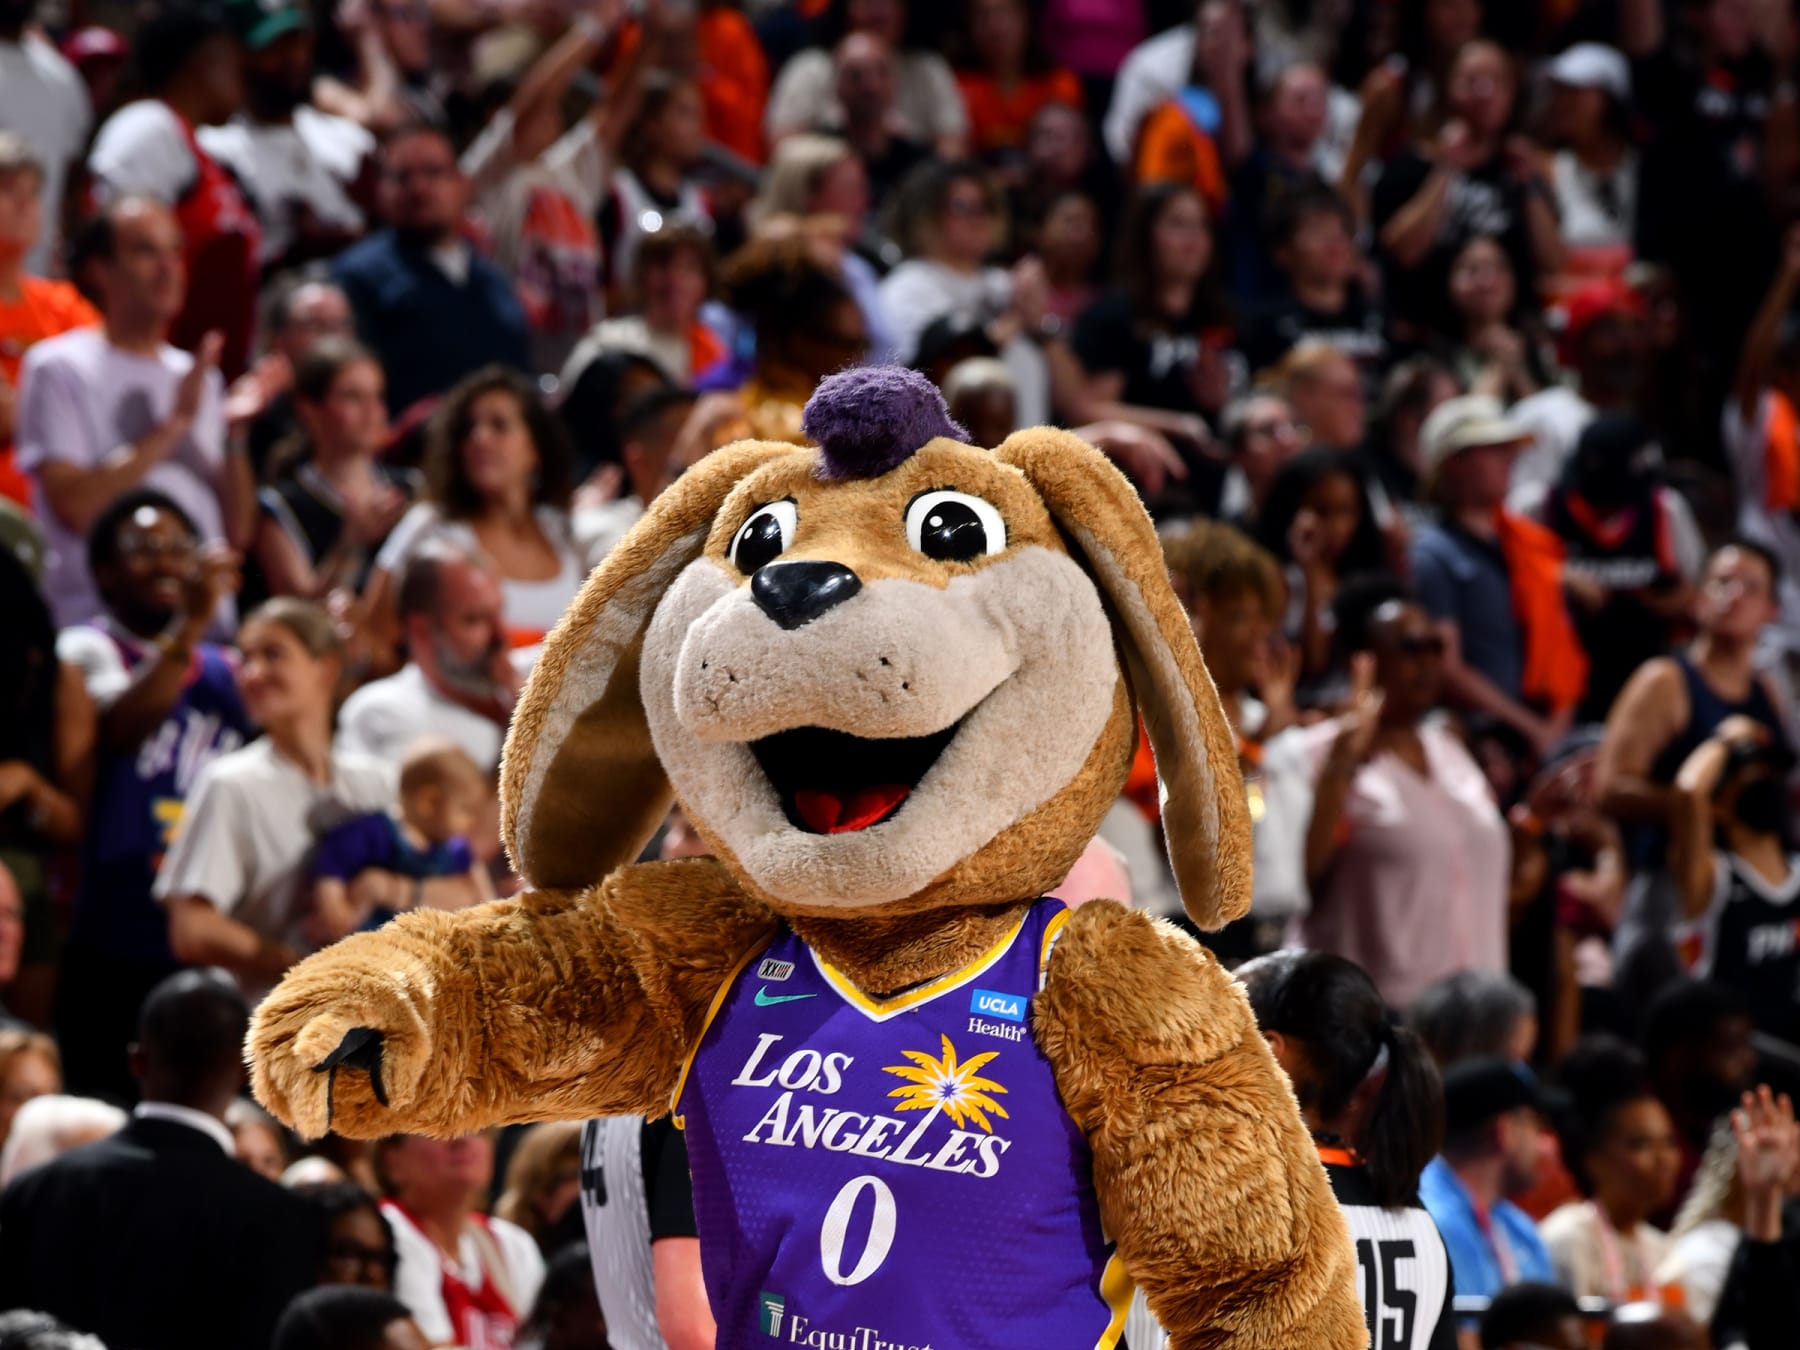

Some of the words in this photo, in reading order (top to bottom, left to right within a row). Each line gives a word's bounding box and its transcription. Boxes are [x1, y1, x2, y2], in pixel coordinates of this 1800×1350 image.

[979, 996, 1018, 1016] UCLA
[731, 1033, 854, 1095] LOS
[743, 1090, 1012, 1179] ANGELES
[820, 1174, 897, 1286] 0
